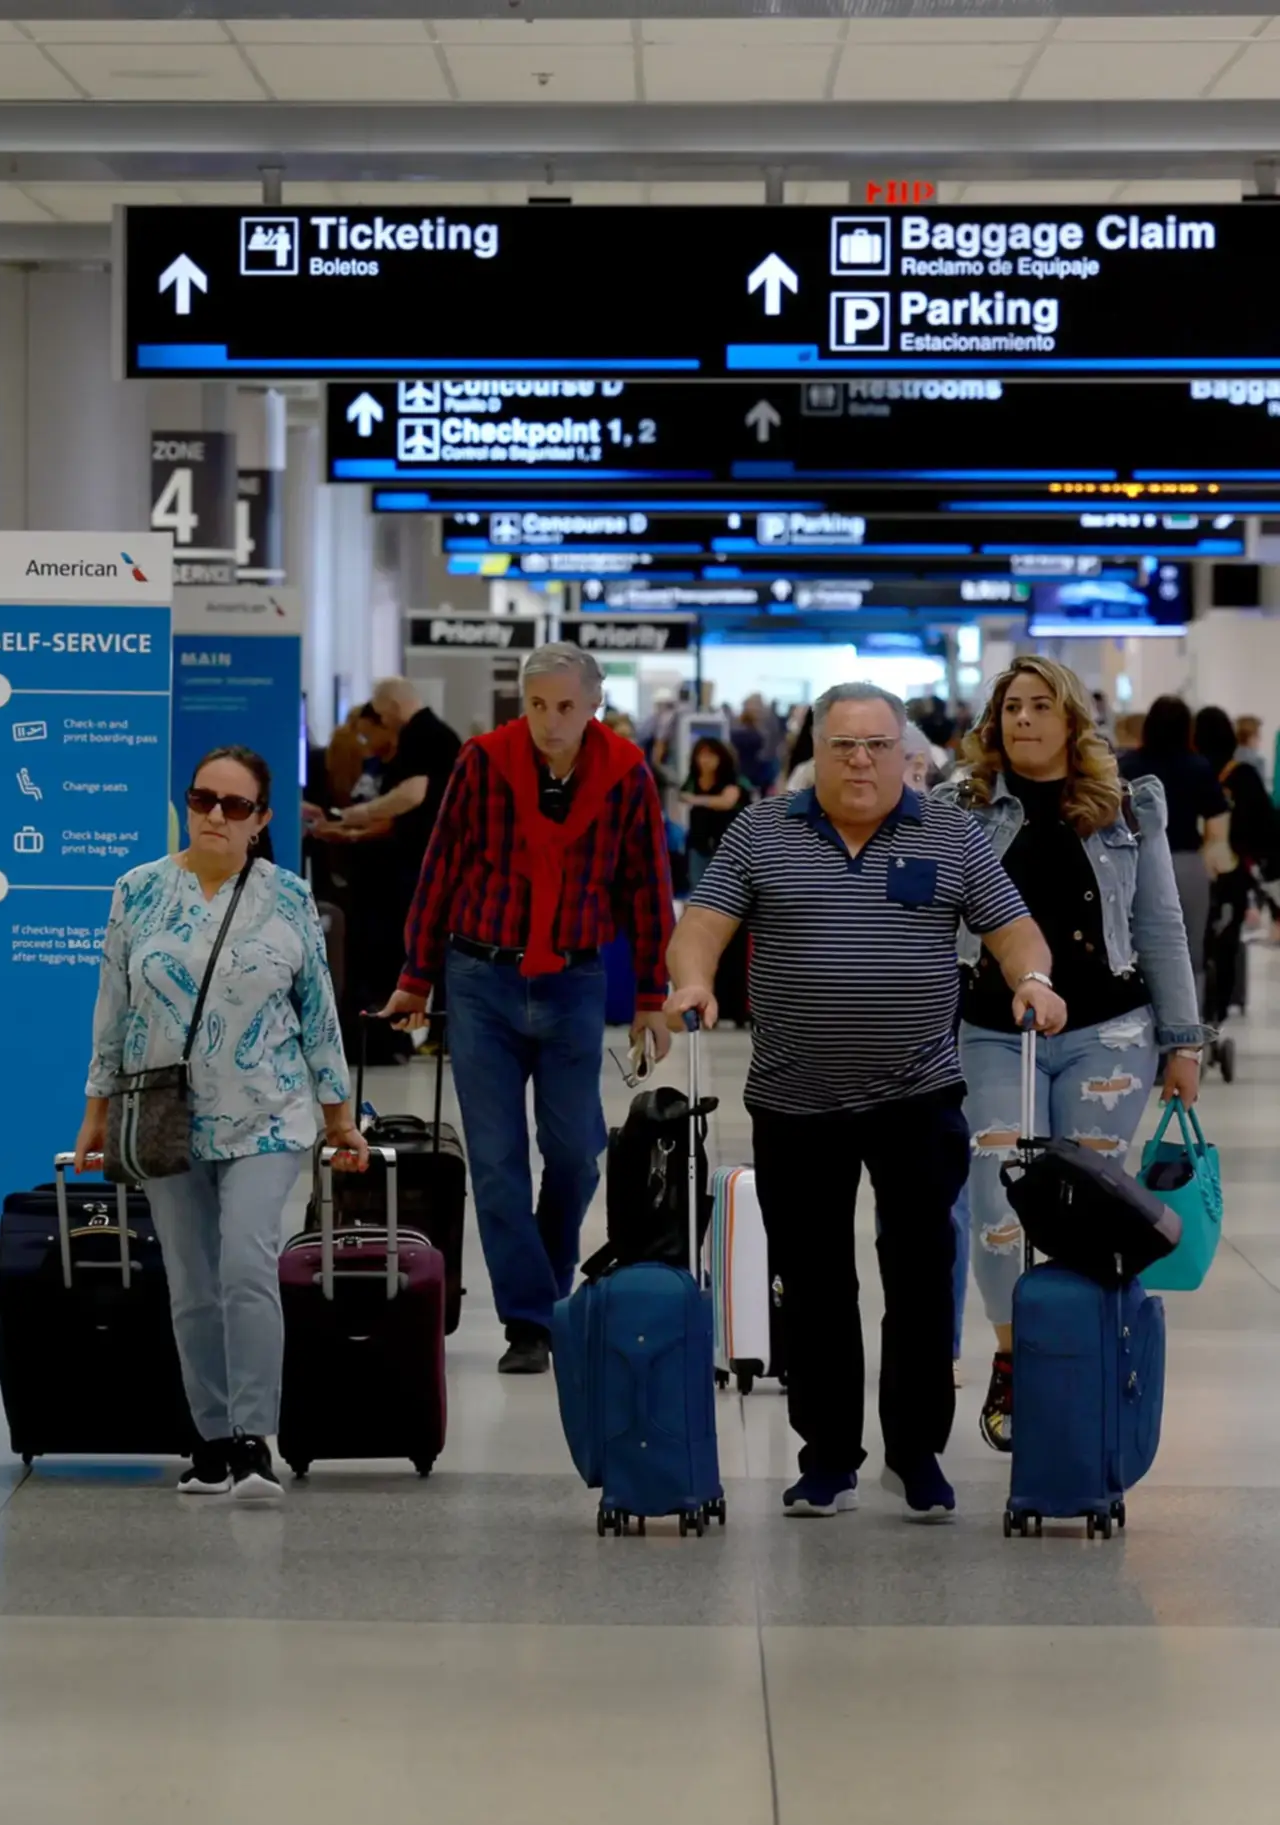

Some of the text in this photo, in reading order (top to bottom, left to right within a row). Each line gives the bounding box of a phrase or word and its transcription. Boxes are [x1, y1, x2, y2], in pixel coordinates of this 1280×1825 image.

[309, 216, 499, 258] Ticketing
[901, 215, 1216, 259] Baggage Claim
[309, 257, 379, 275] Boletos
[901, 257, 1100, 278] Reclamo de Equipaje
[901, 292, 1058, 333] Parking
[901, 333, 1055, 351] Estacionamiento
[442, 417, 601, 448] Checkpoint
[638, 418, 657, 443] 2
[152, 440, 205, 461] ZONE
[151, 468, 198, 543] 4
[26, 559, 118, 577] American
[430, 620, 514, 647] Priority
[579, 622, 669, 650] Priority
[181, 652, 231, 667] MAIN
[63, 719, 128, 730] Check-in and
[63, 733, 157, 745] print boarding pass
[63, 781, 128, 793] Change seats
[62, 830, 138, 843] Check bags and
[62, 845, 129, 857] print bag tags
[21, 924, 65, 938] checking
[12, 939, 52, 951] proceed
[55, 940, 66, 949] to
[68, 939, 91, 949] BAG
[12, 952, 36, 962] after
[39, 953, 75, 965] tagging
